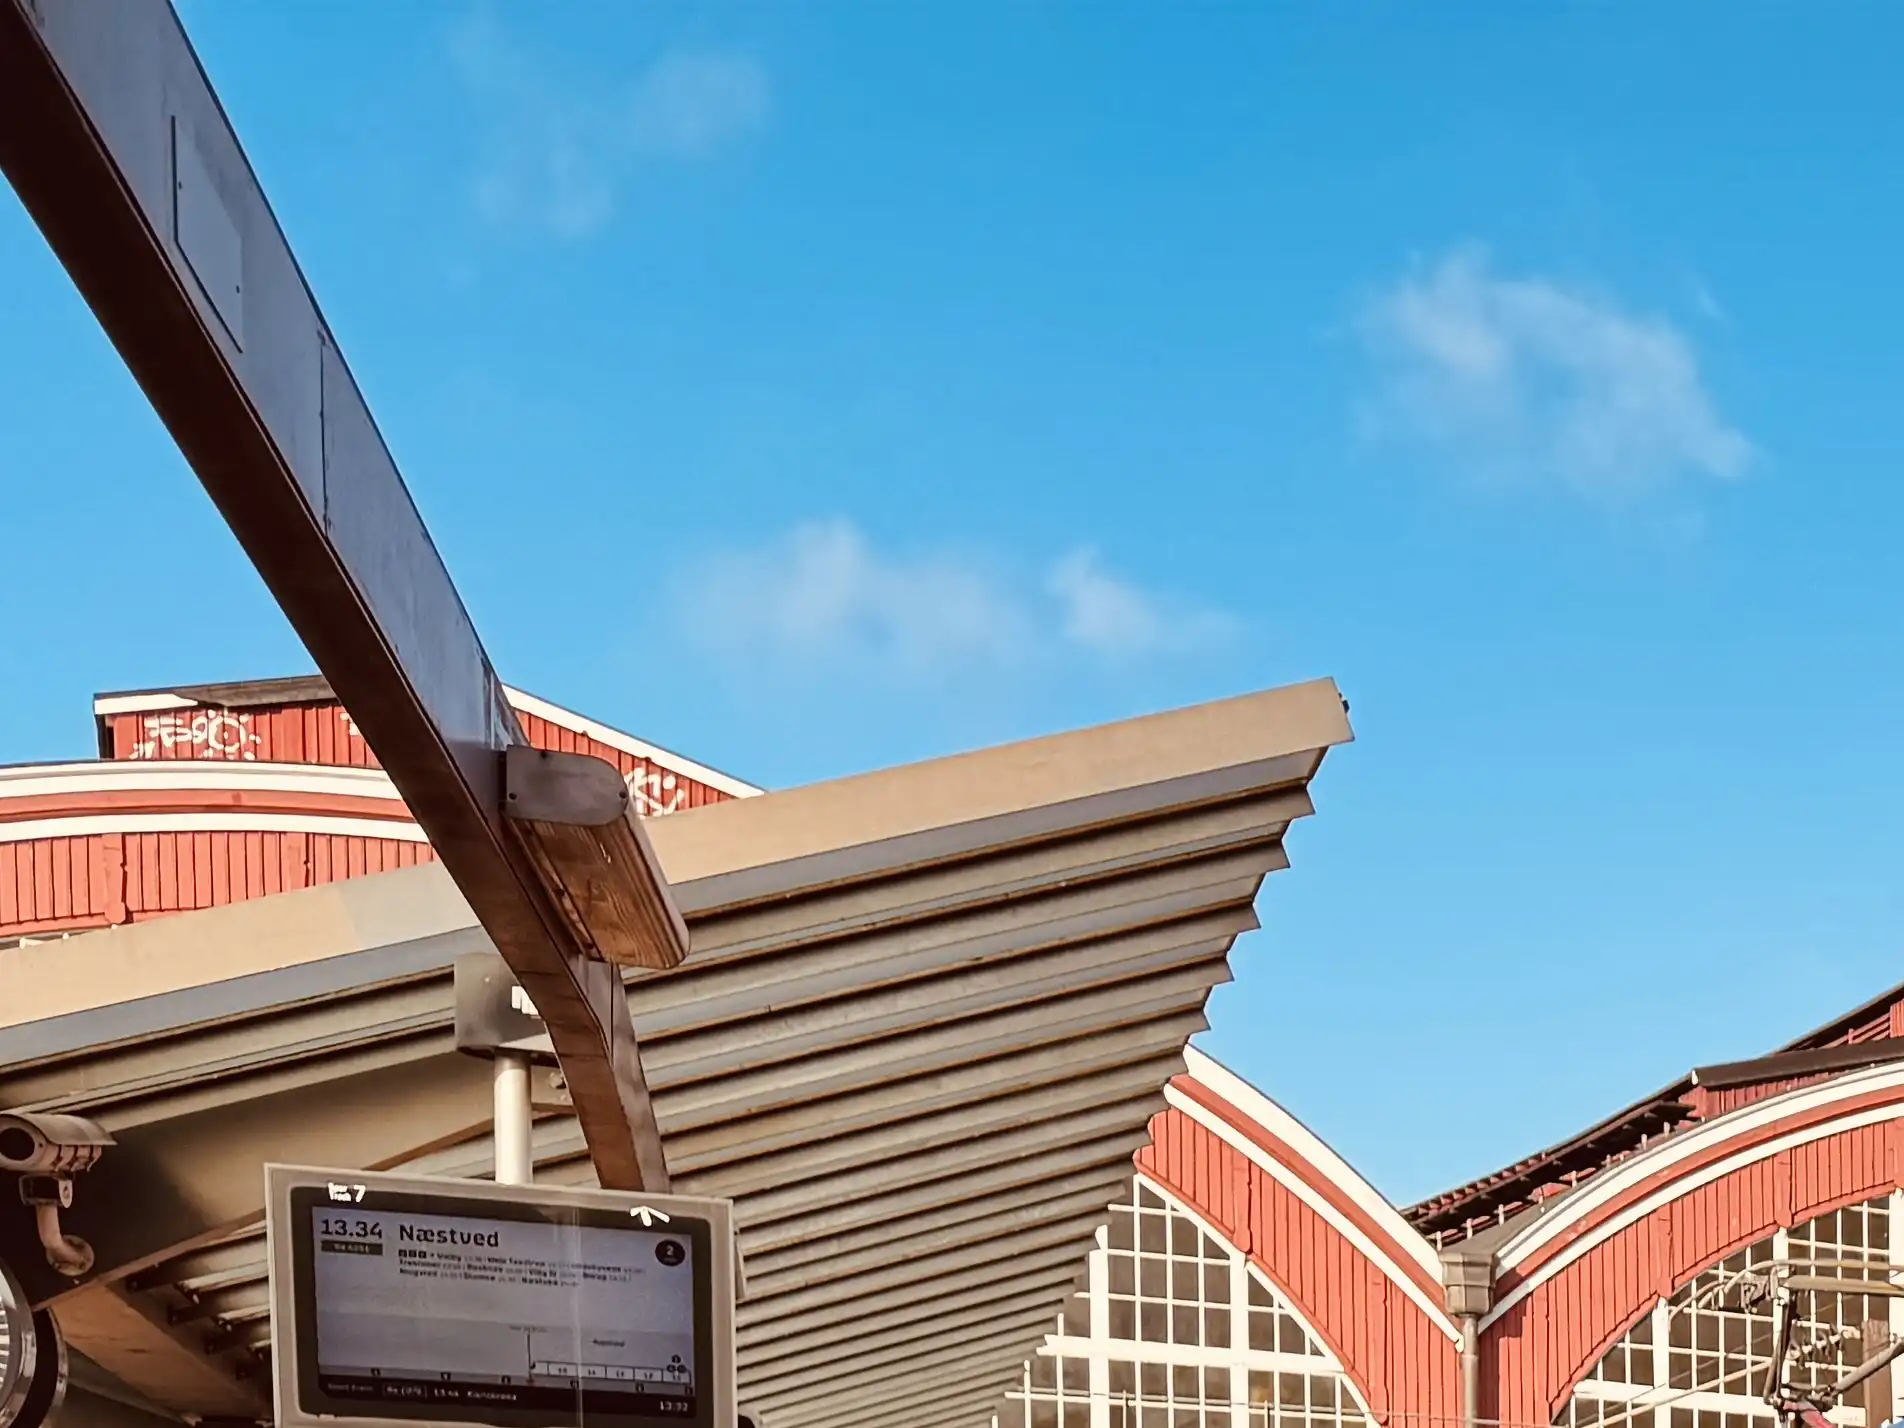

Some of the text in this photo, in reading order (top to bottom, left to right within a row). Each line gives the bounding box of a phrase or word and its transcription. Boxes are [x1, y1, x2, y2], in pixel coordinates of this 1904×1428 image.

[354, 1185, 366, 1202] 7
[321, 1219, 499, 1248] 13.34 Næstved
